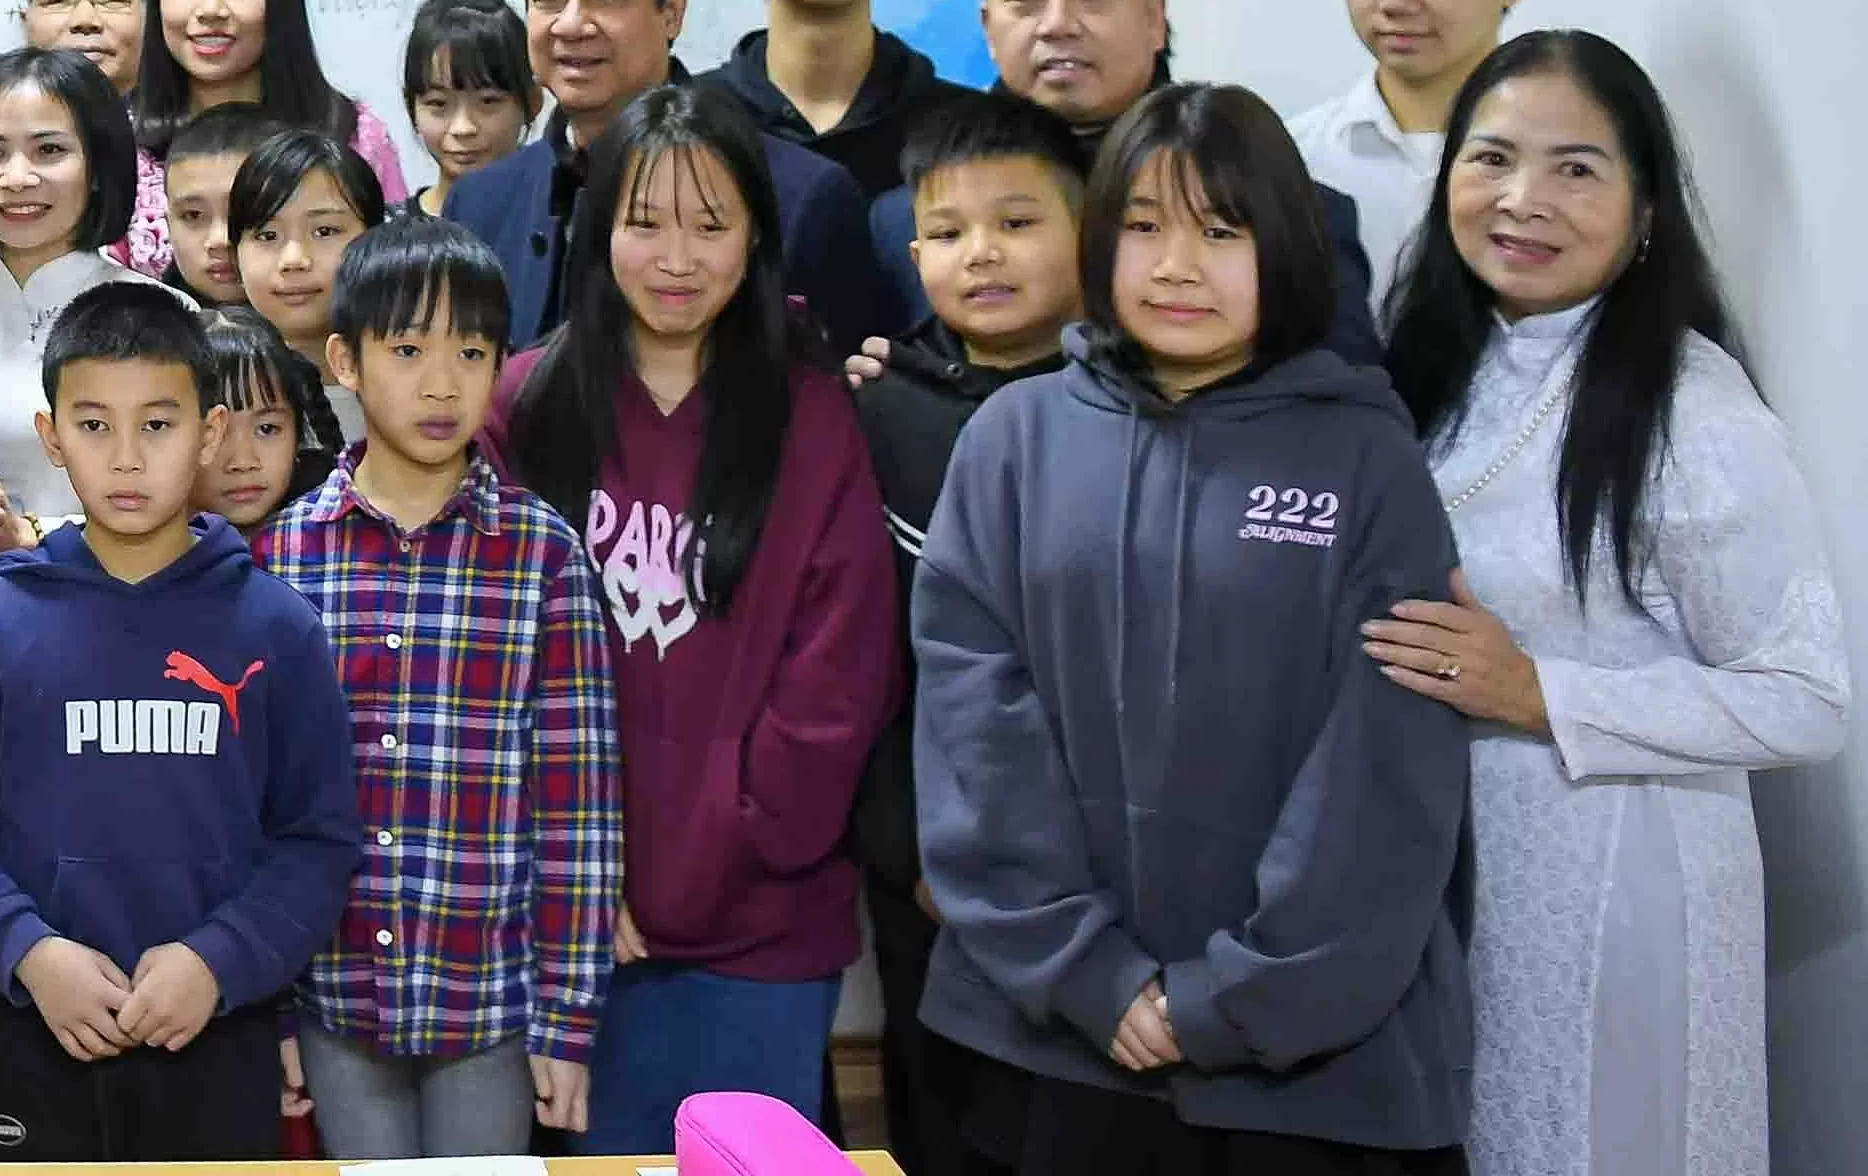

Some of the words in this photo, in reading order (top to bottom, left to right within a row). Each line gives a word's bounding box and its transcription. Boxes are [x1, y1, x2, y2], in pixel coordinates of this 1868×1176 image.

[1244, 485, 1339, 528] 222
[1237, 523, 1337, 548] ALIGNMENT
[64, 699, 221, 756] PUMA
